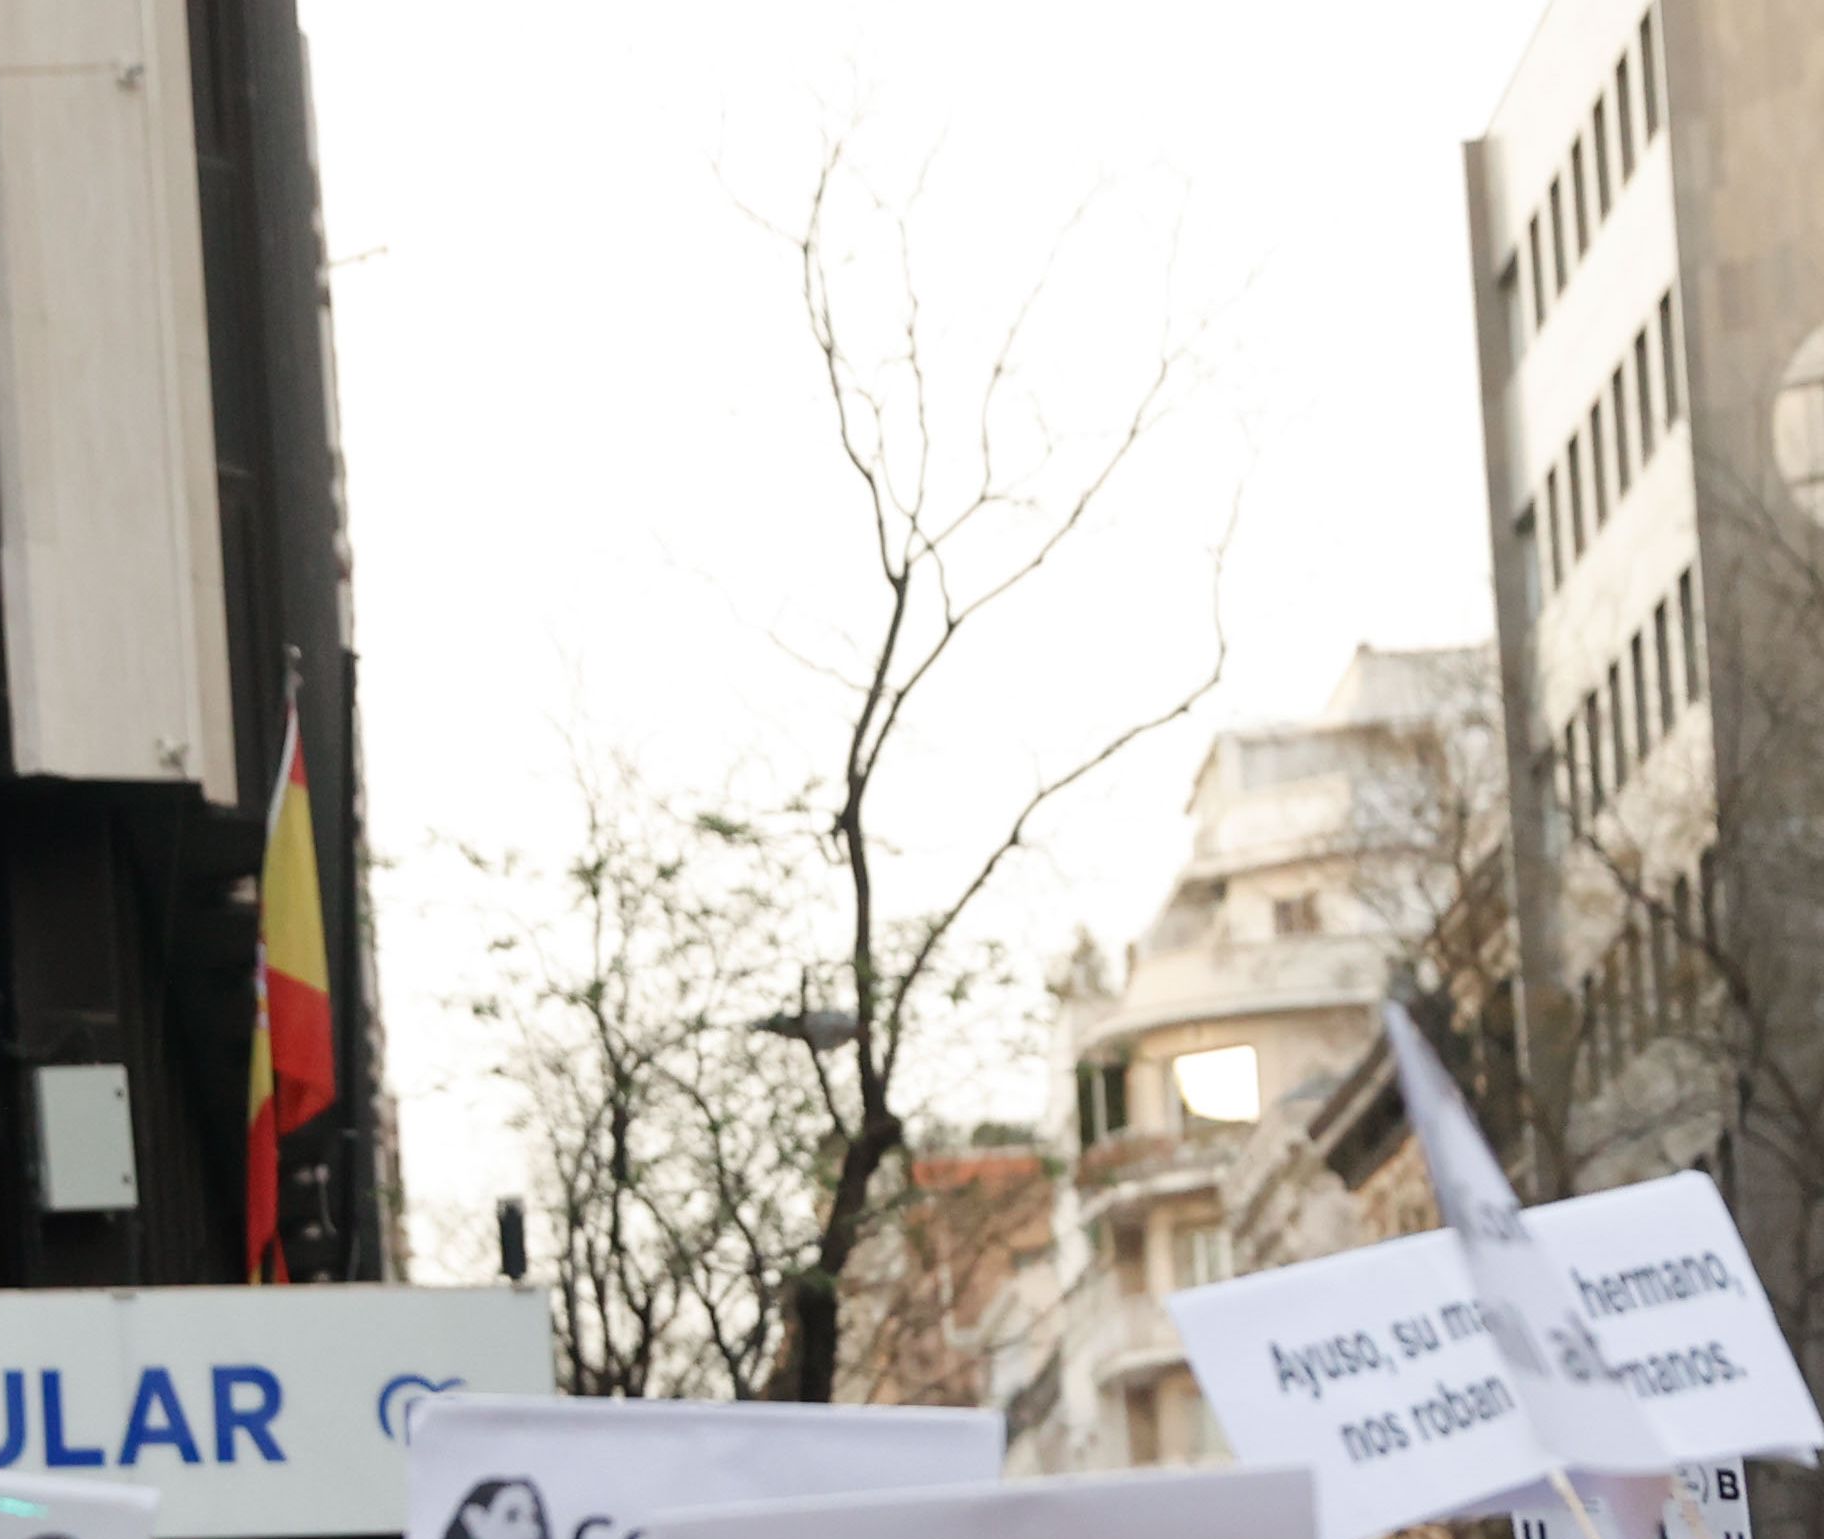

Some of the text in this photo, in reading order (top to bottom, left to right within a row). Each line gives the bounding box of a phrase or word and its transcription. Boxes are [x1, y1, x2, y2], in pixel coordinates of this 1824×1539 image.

[1269, 1331, 1399, 1400] Ayuso,
[1392, 1314, 1441, 1359] su
[1569, 1250, 1747, 1321] hermano,
[1339, 1411, 1411, 1463] nos
[1411, 1376, 1517, 1443] roban
